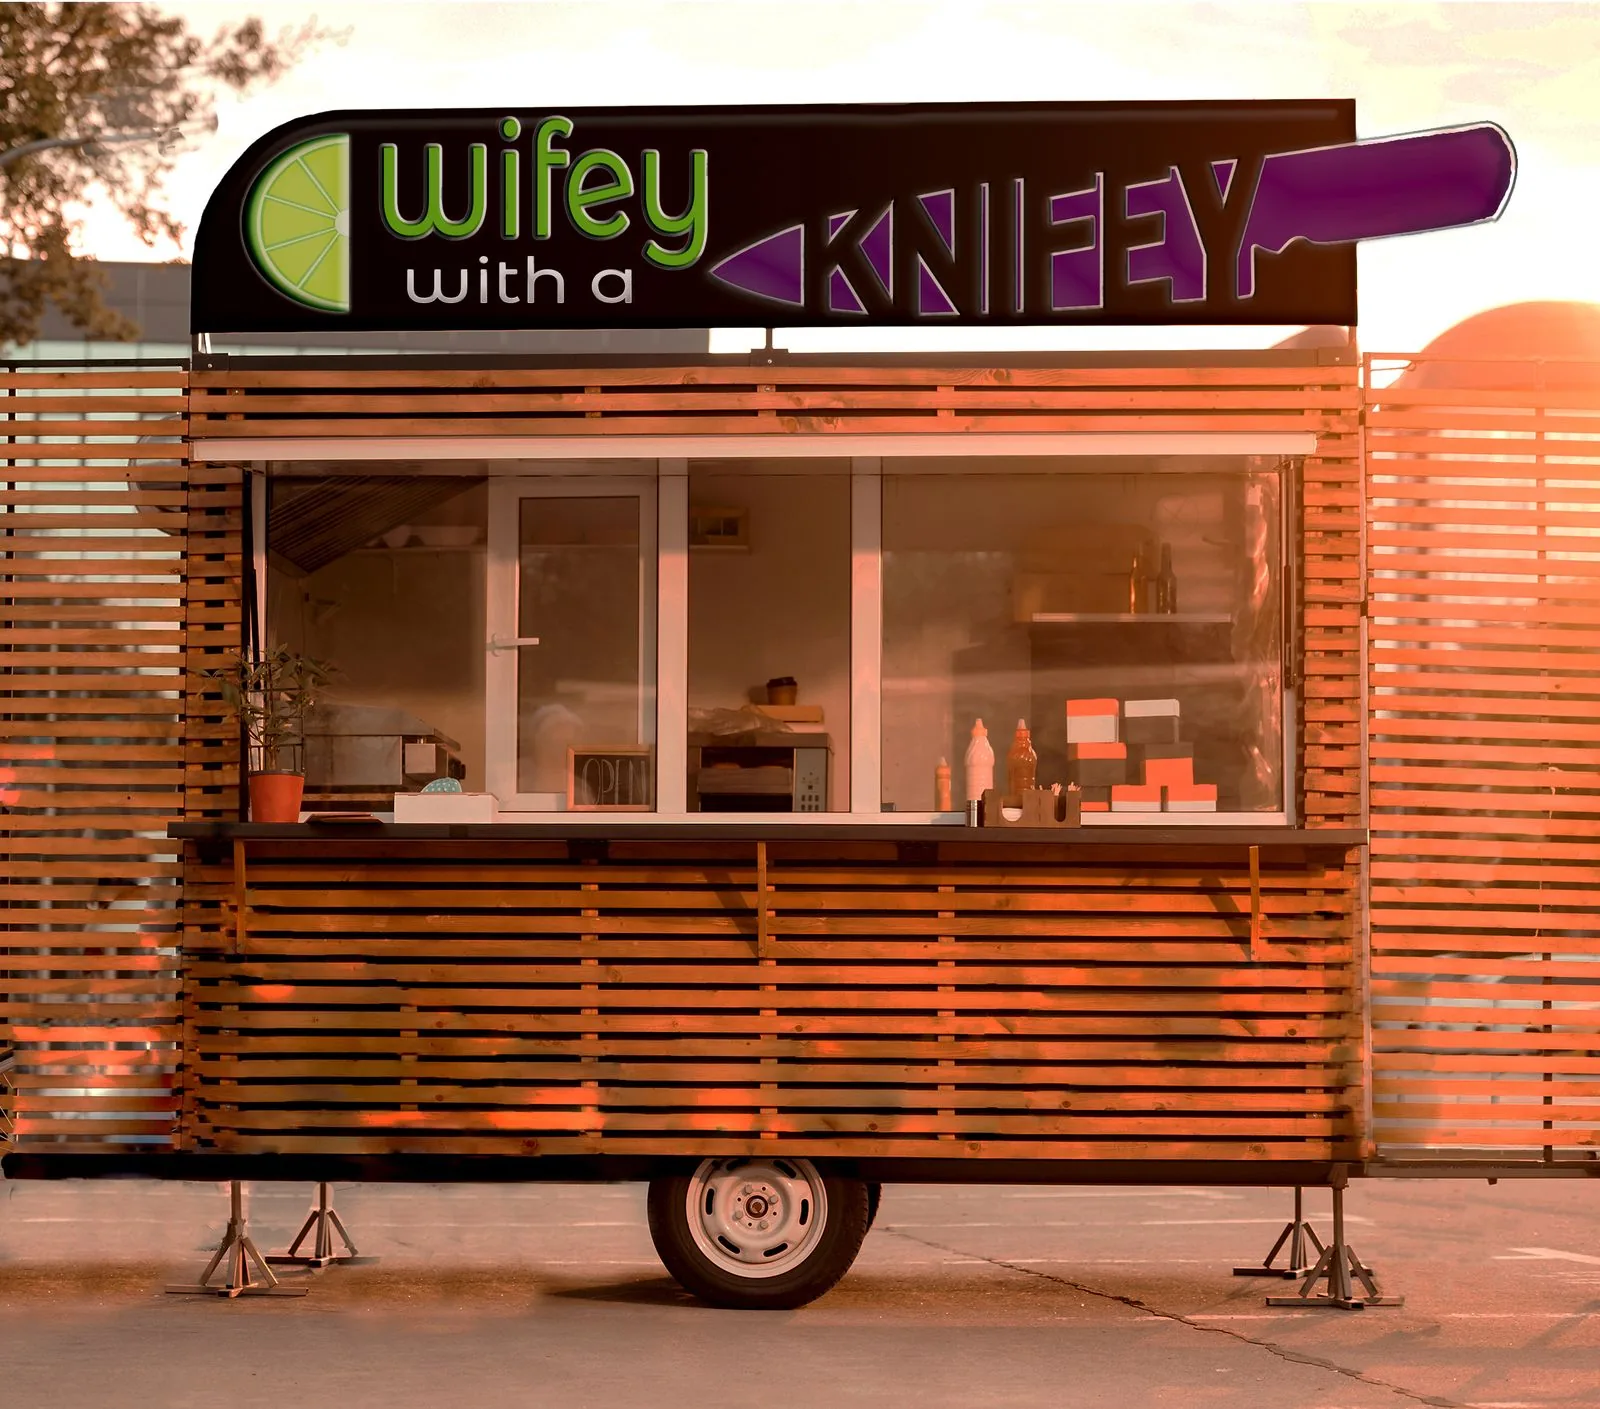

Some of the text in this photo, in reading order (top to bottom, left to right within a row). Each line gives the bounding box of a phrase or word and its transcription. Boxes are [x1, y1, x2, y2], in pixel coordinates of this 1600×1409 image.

[379, 115, 709, 270] wifey
[406, 155, 1266, 317] with a KNIFEY
